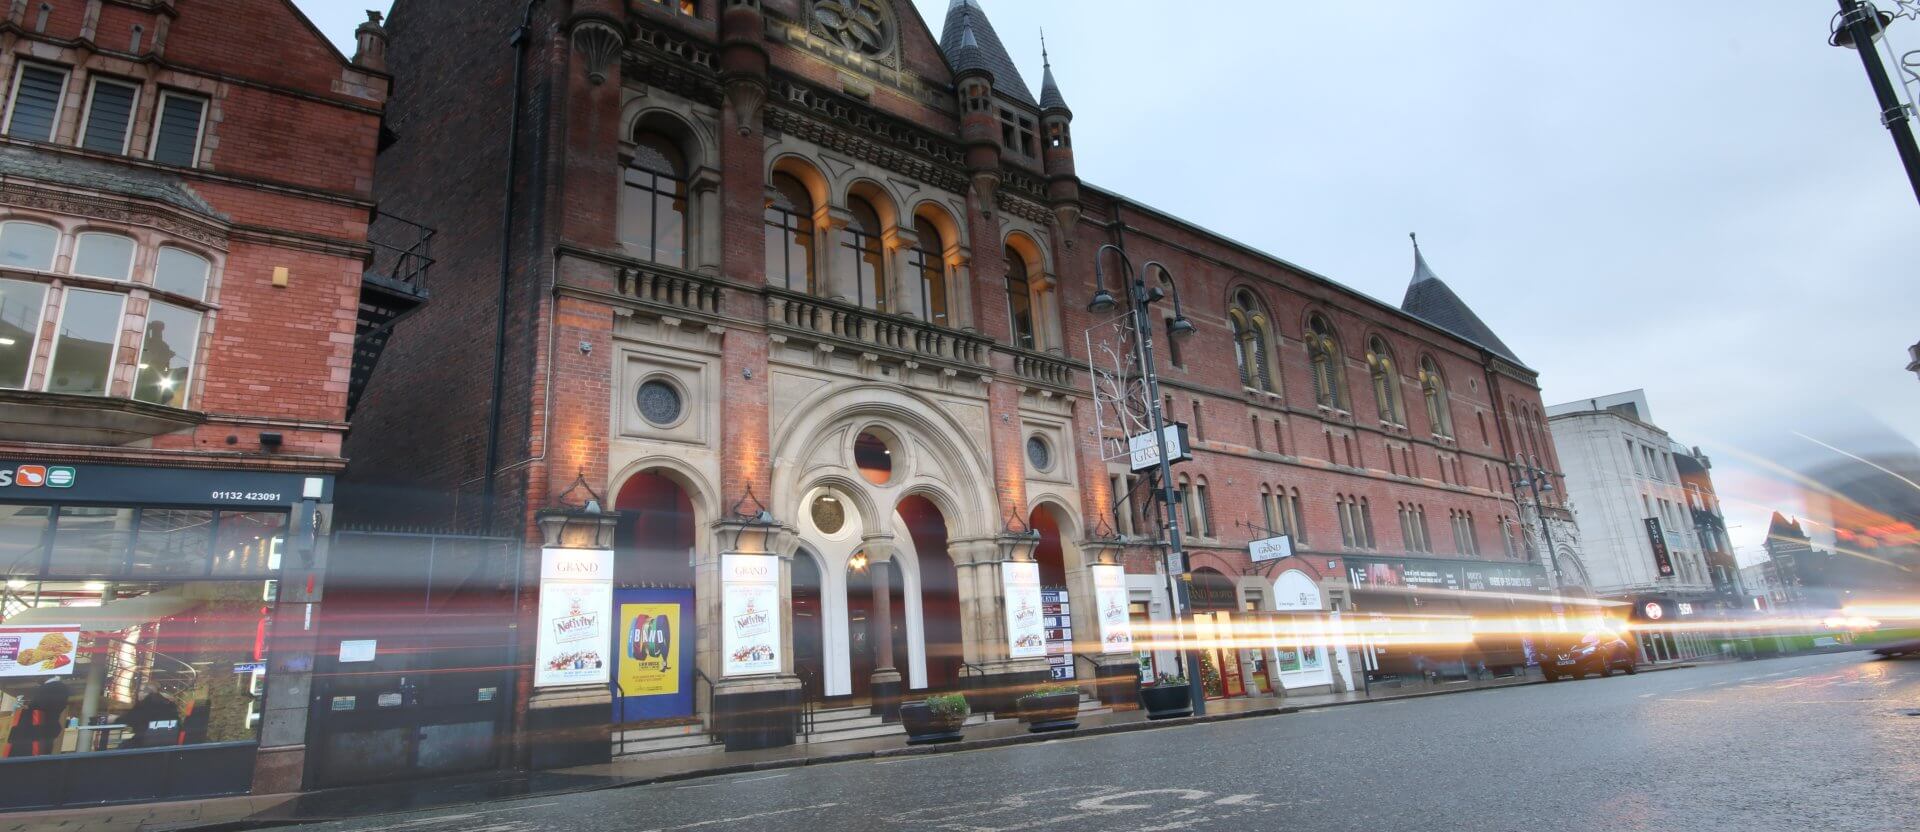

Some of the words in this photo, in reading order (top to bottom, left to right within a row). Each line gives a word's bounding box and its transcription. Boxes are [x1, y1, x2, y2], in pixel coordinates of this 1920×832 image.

[1135, 440, 1176, 462] GRAD
[212, 491, 242, 500] 01132
[244, 492, 281, 501] 423091
[1258, 544, 1281, 554] GRAND
[557, 560, 599, 573] GRAND
[735, 566, 768, 576] GRAND
[557, 615, 595, 634] Nativity!
[737, 613, 767, 630] Nativity!
[634, 628, 664, 643] BAND
